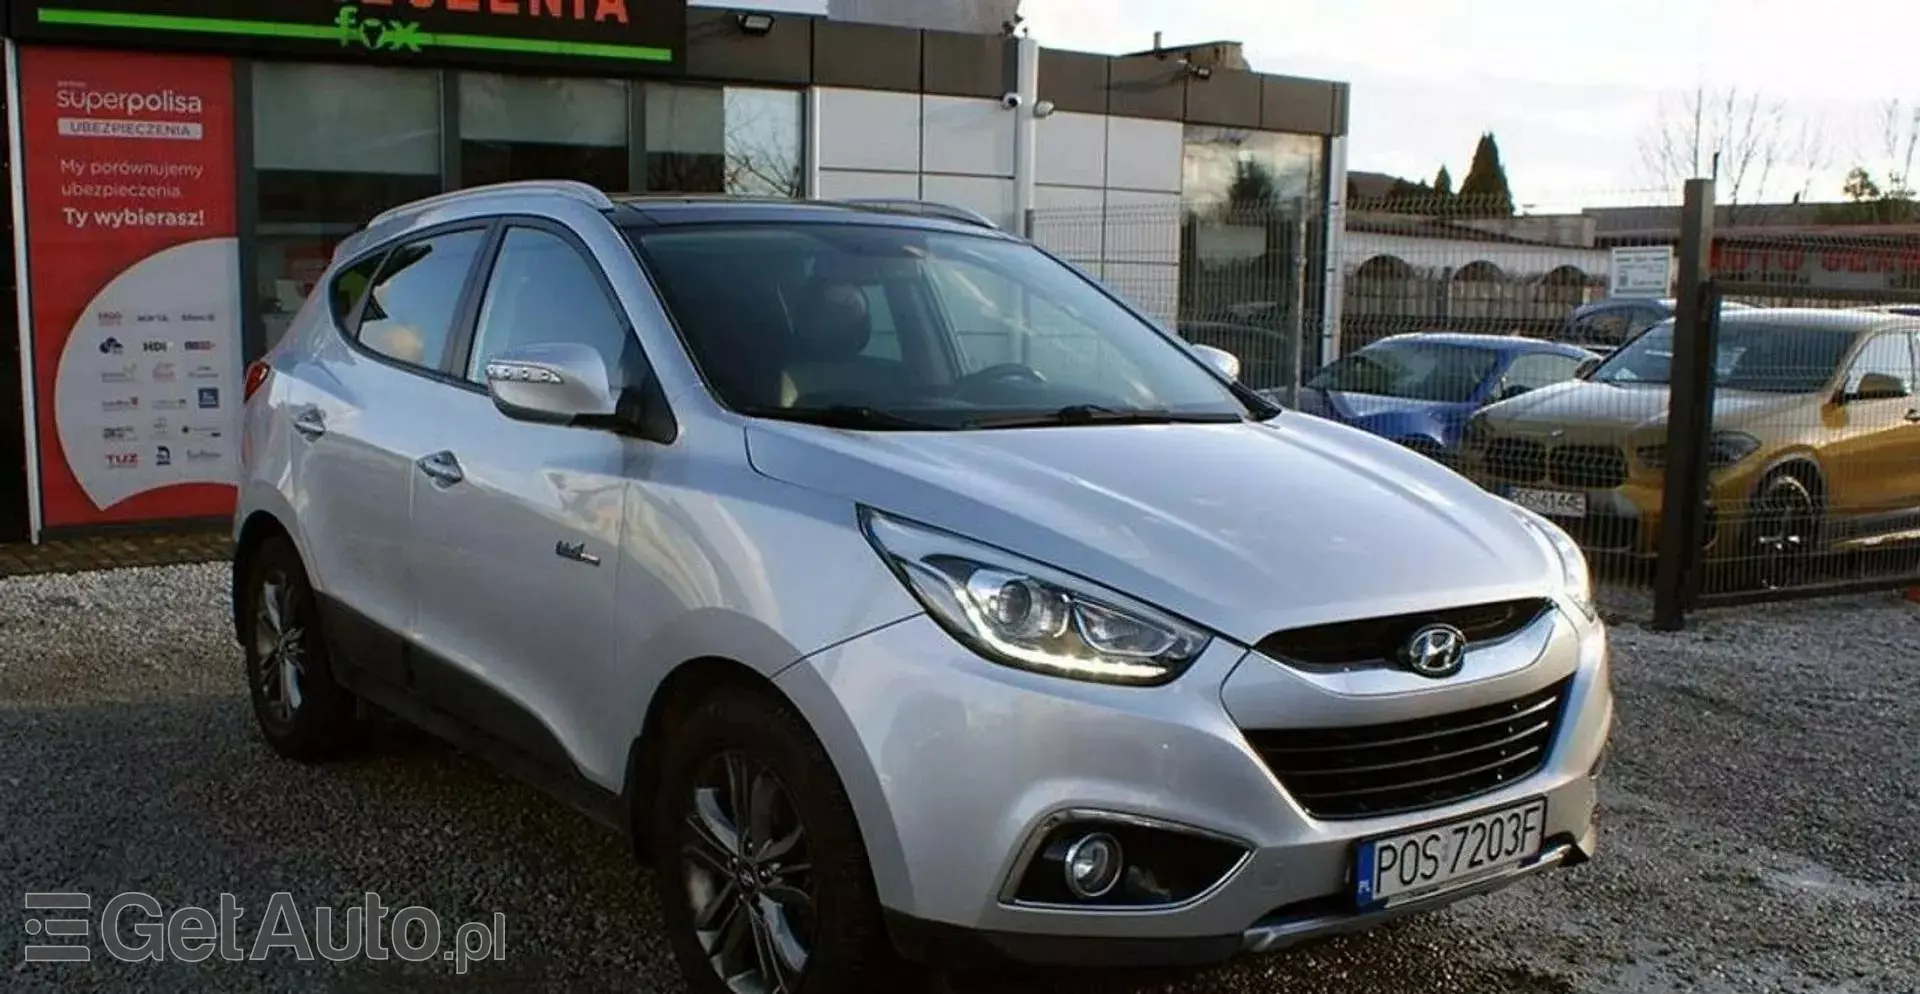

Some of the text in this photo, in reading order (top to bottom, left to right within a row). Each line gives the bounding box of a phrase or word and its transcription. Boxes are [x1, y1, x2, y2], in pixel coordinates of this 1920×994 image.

[57, 89, 202, 116] superpolisa
[70, 121, 192, 137] UBEZPIECZENIA
[60, 158, 204, 180] My porównujemy
[62, 206, 204, 228] Ty wybierasz!
[1375, 806, 1541, 894] POS 7203F
